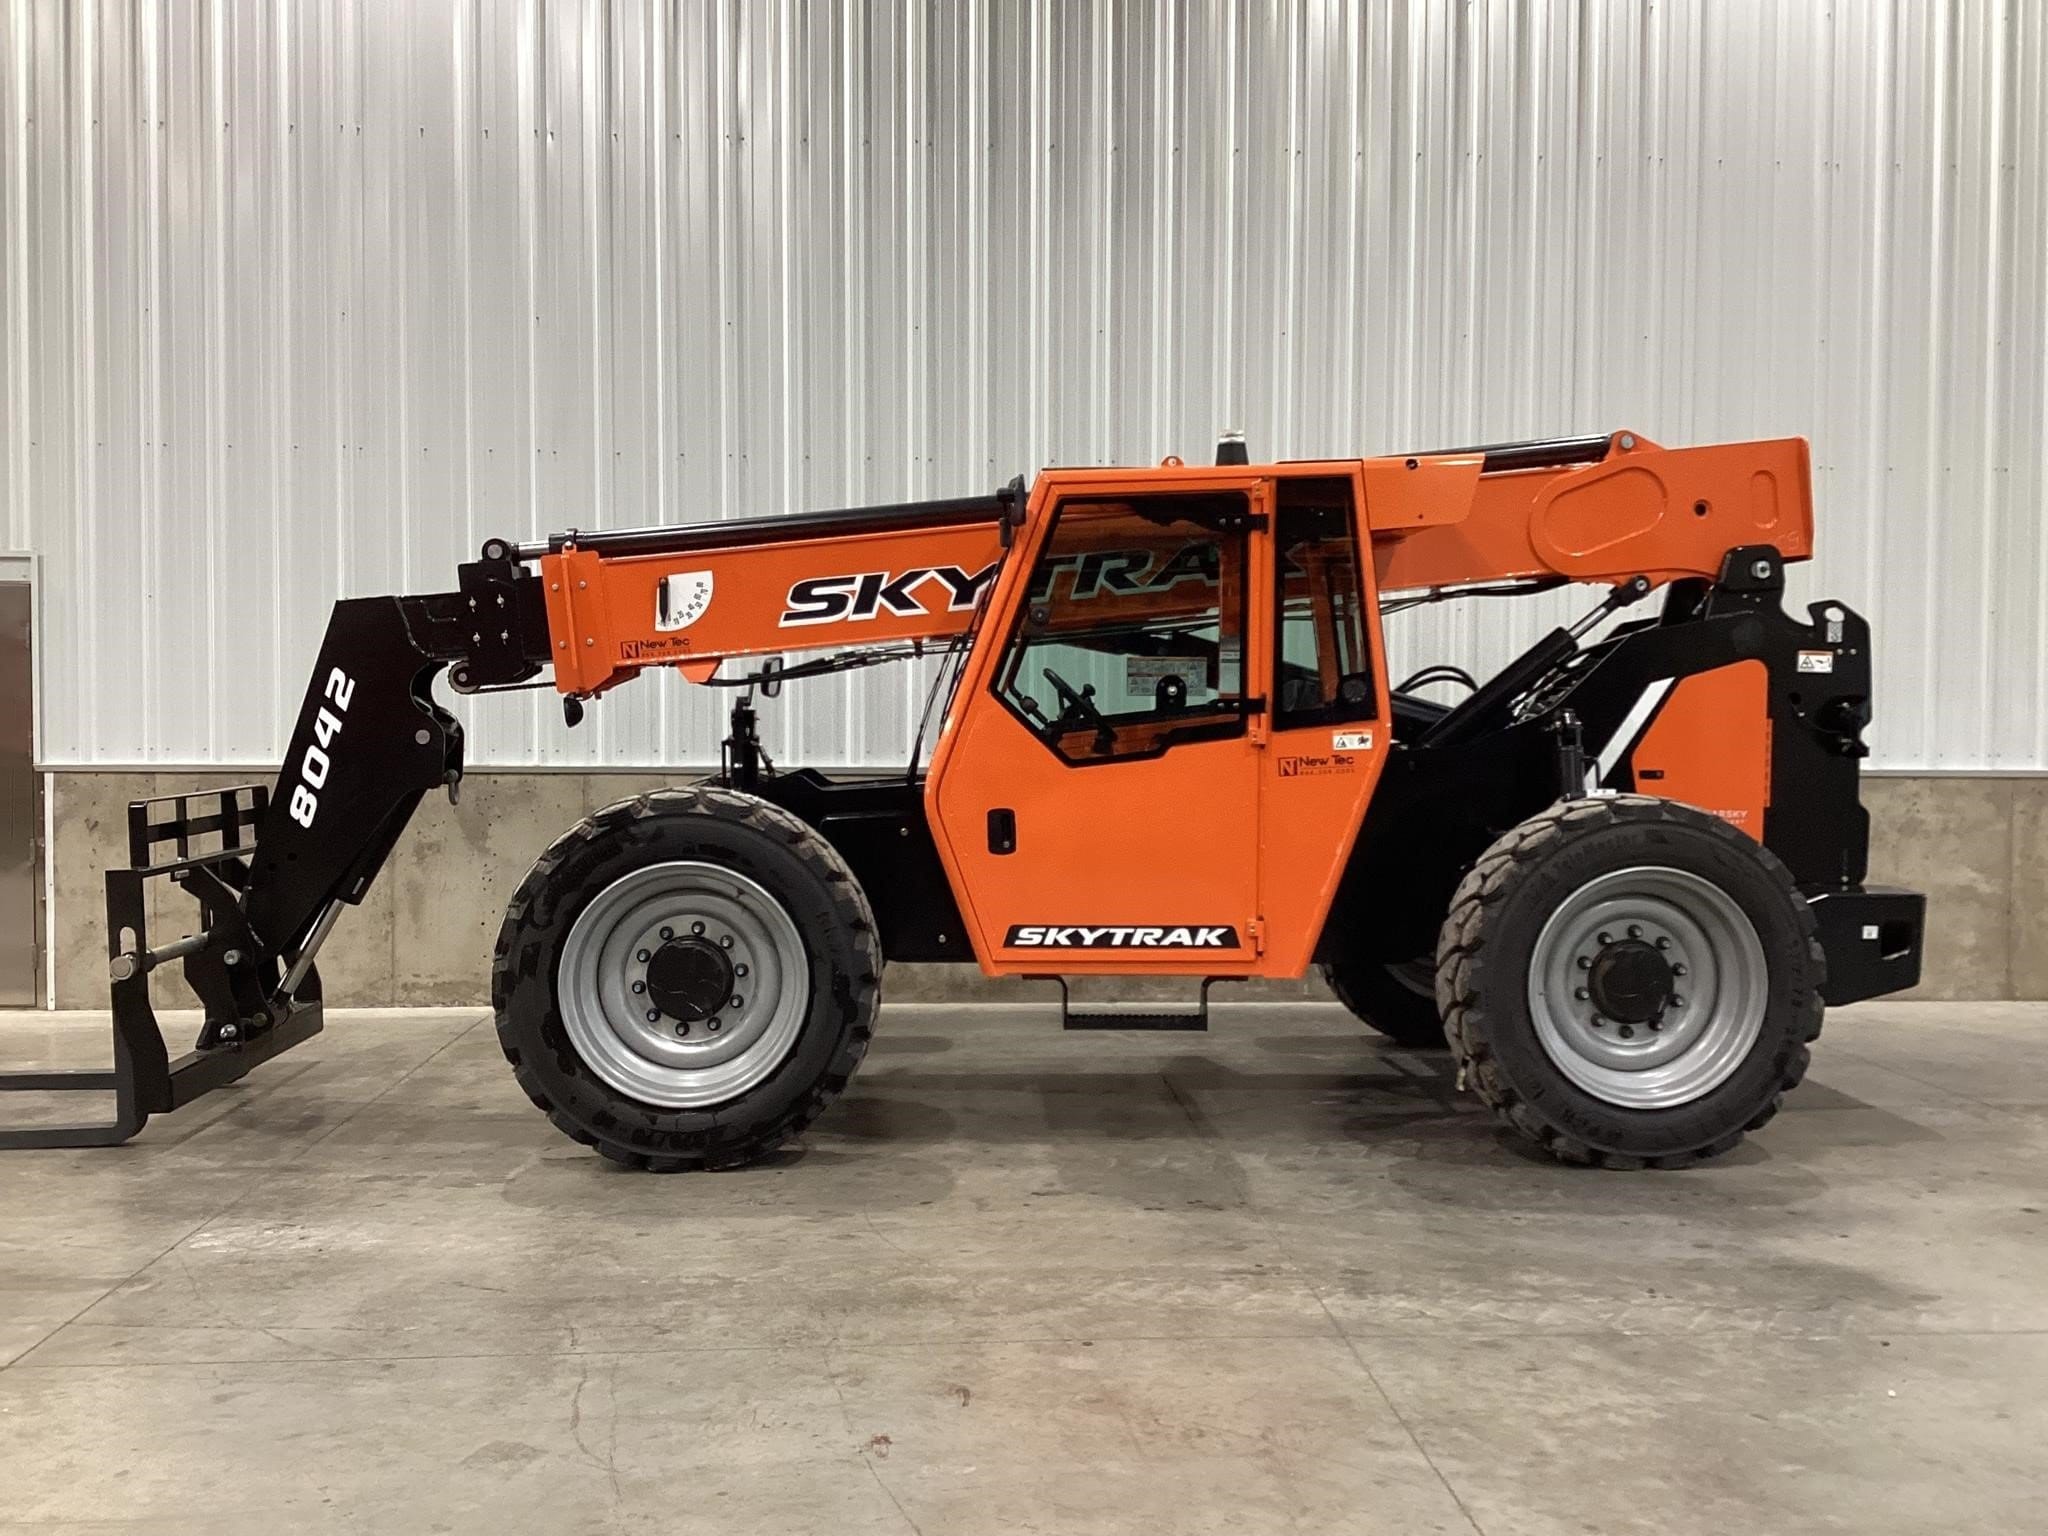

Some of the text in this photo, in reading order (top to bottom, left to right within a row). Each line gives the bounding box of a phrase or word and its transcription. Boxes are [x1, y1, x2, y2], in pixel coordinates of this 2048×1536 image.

[640, 640, 667, 649] New
[669, 636, 690, 647] Tec
[289, 666, 356, 829] 8042
[1299, 756, 1330, 767] New
[1331, 754, 1354, 765] Tec
[1014, 928, 1228, 946] SKYTRAK
